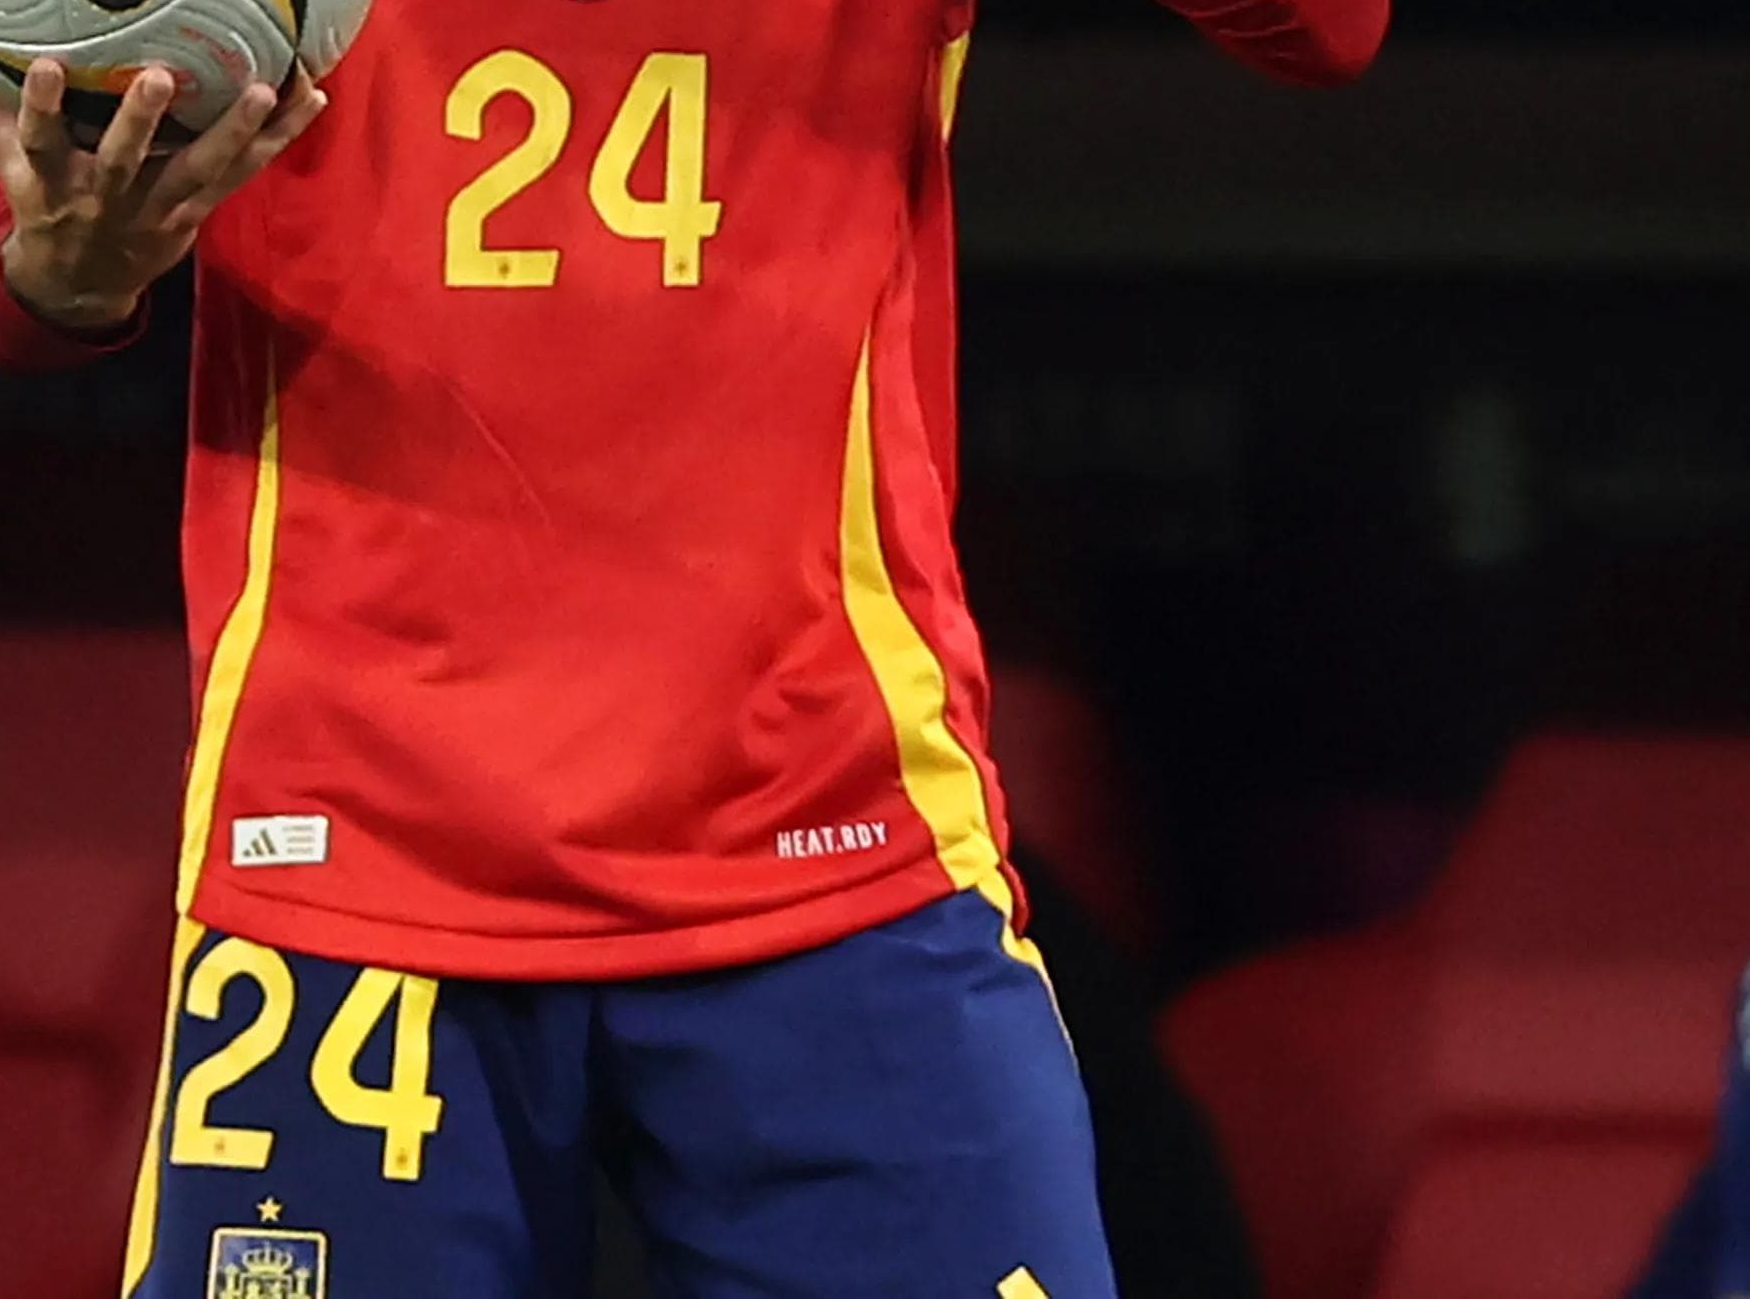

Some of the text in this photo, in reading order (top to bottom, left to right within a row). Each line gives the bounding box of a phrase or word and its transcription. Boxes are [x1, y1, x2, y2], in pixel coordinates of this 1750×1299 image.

[445, 50, 721, 287] 24
[777, 822, 887, 859] HEAT.RDY
[170, 936, 443, 1181] 24
